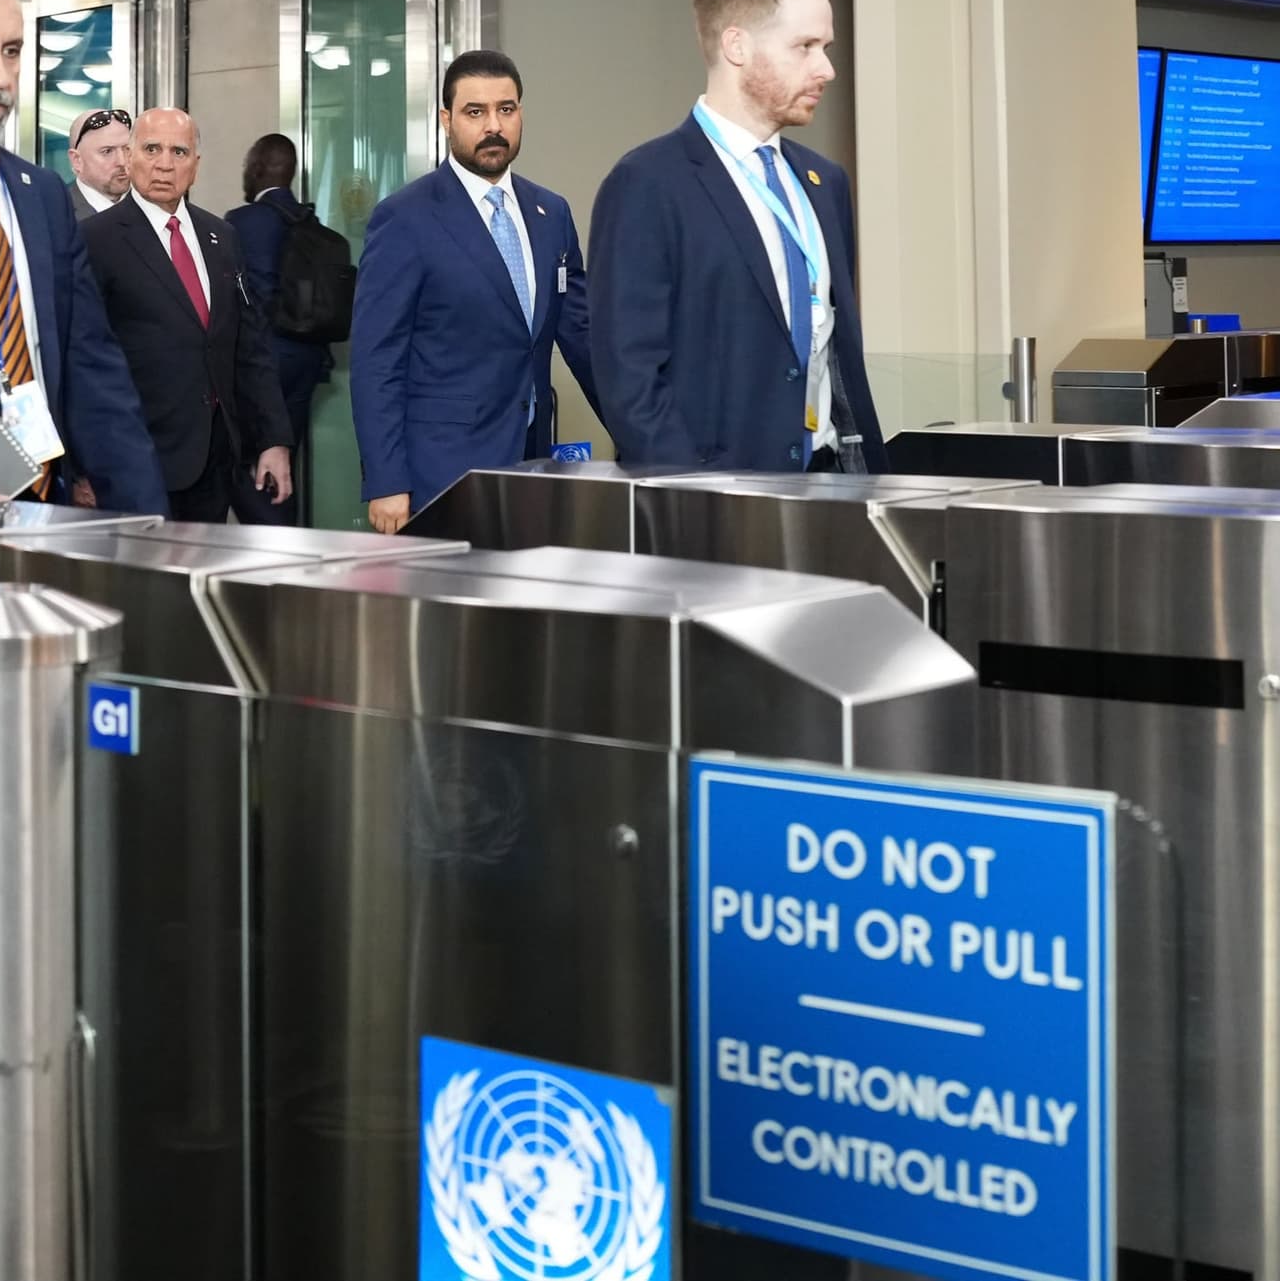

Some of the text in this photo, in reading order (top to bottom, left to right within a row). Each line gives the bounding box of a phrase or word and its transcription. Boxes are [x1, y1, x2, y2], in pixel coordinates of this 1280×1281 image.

[92, 698, 129, 738] G1
[786, 822, 996, 899] DO NOT
[711, 885, 1083, 991] PUSH OR PULL
[716, 1037, 1077, 1147] ELECTRONICALLY
[751, 1119, 1038, 1216] CONTROLLED
